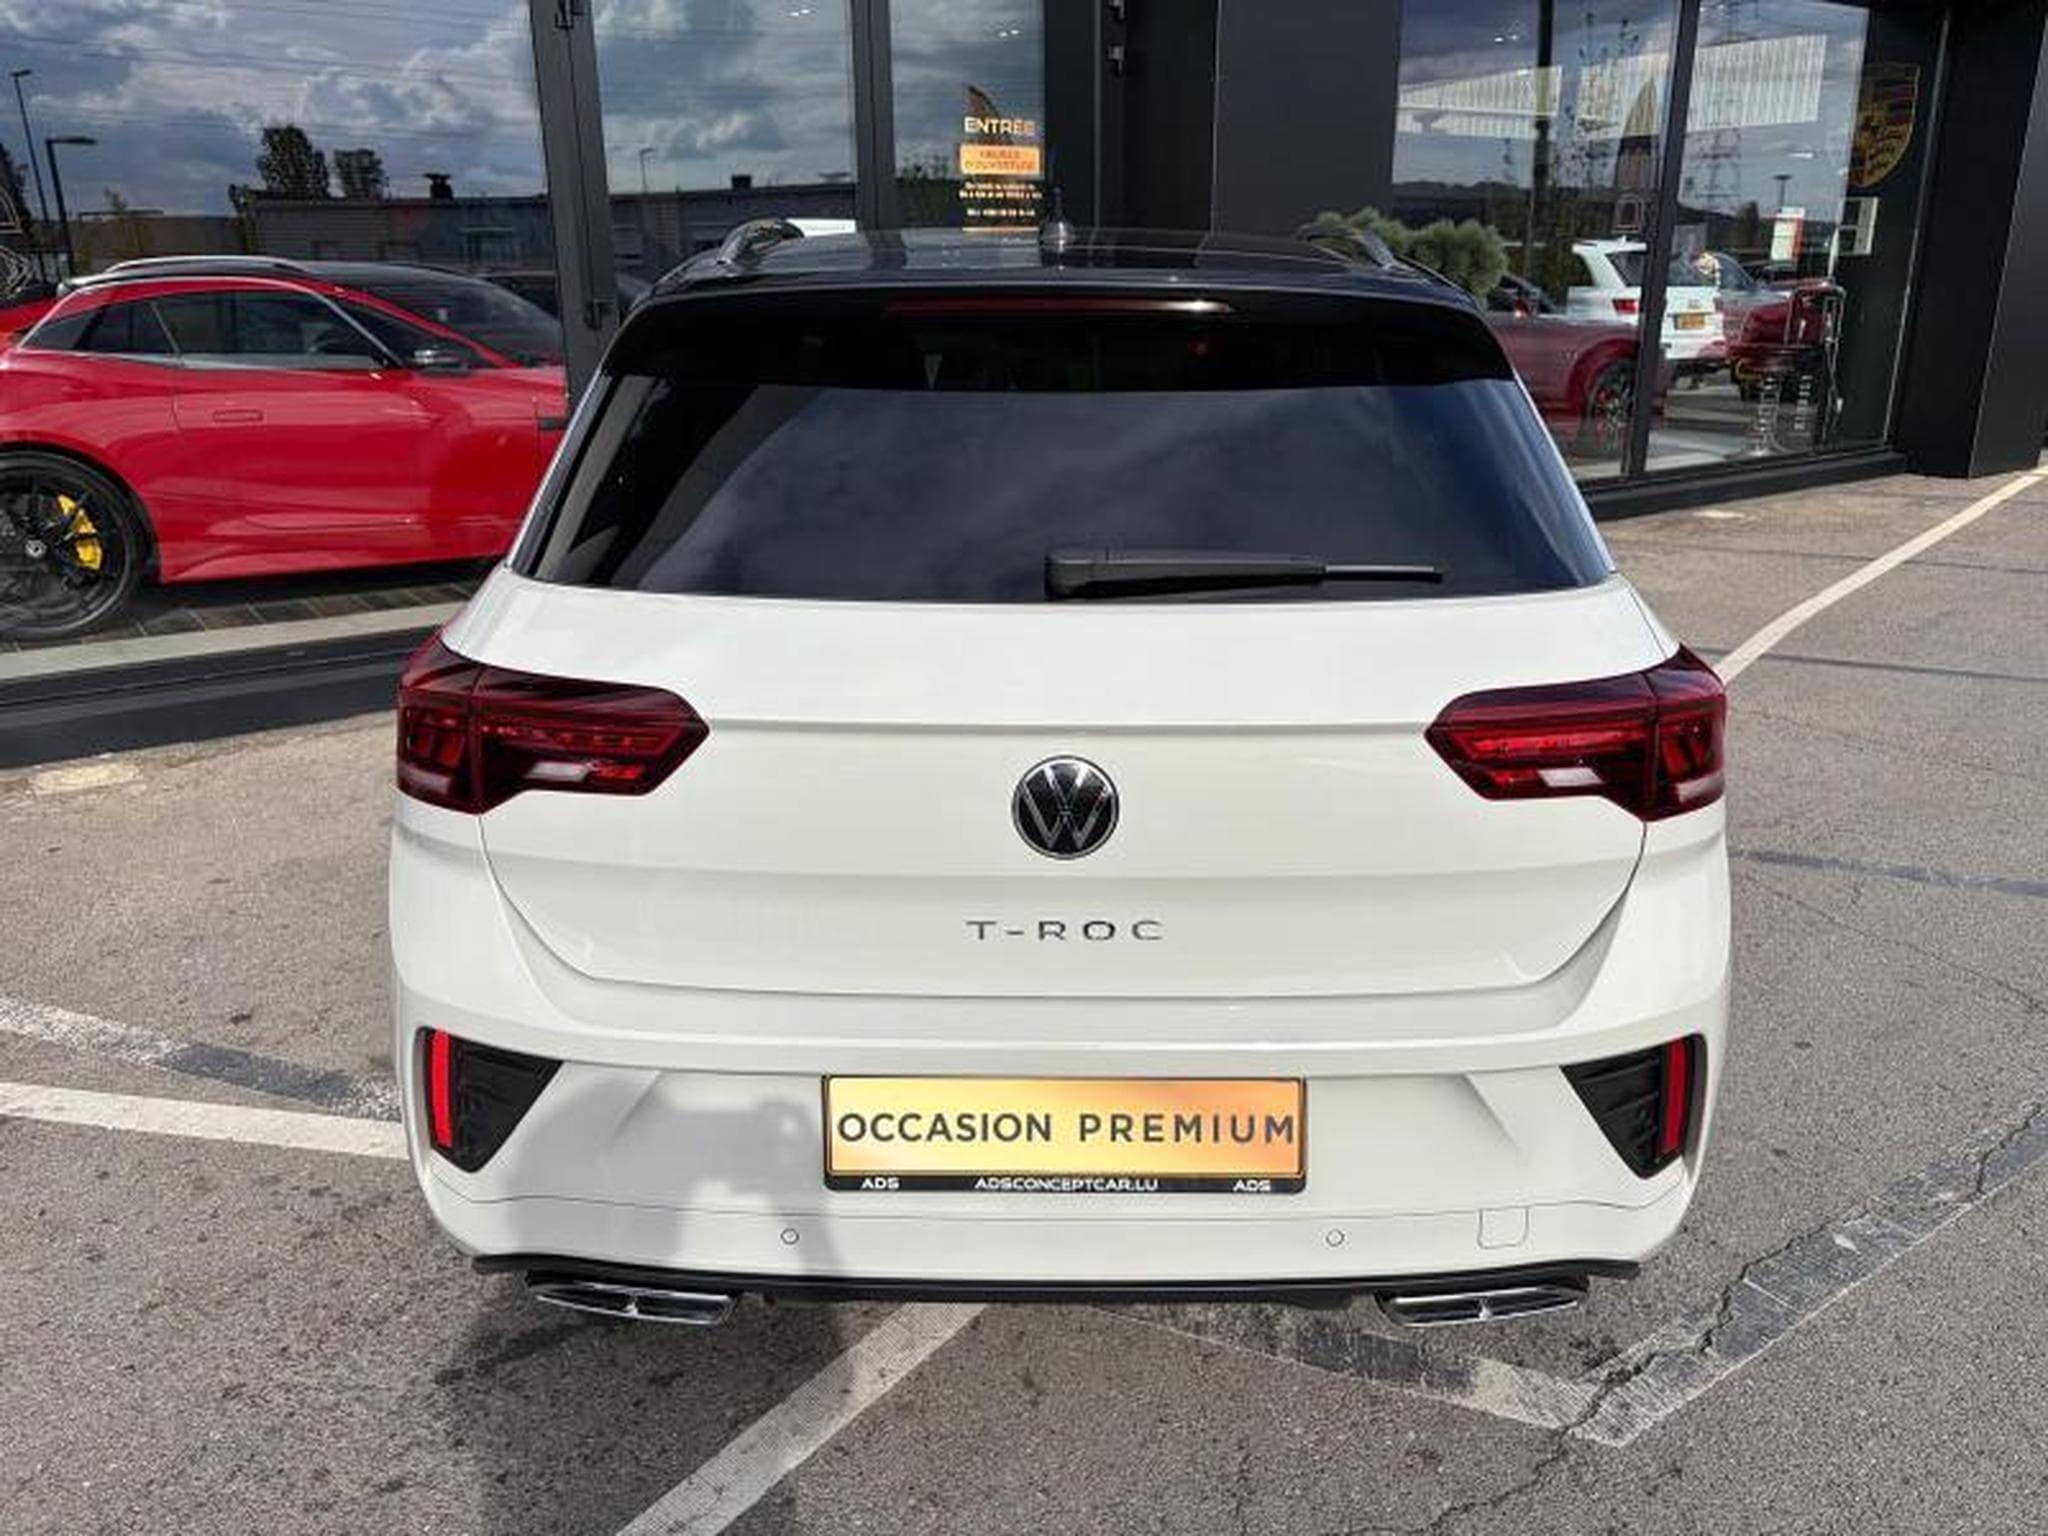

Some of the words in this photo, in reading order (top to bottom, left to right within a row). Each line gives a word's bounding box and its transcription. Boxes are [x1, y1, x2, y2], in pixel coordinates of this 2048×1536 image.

[965, 920, 1164, 941] T-ROC
[838, 1113, 1052, 1142] OCCASION
[1079, 1114, 1294, 1143] PREMIUM
[861, 1177, 899, 1190] ADS
[975, 1177, 1159, 1192] ADSCONCEPTCAR.LU
[1233, 1179, 1271, 1192] ADS
